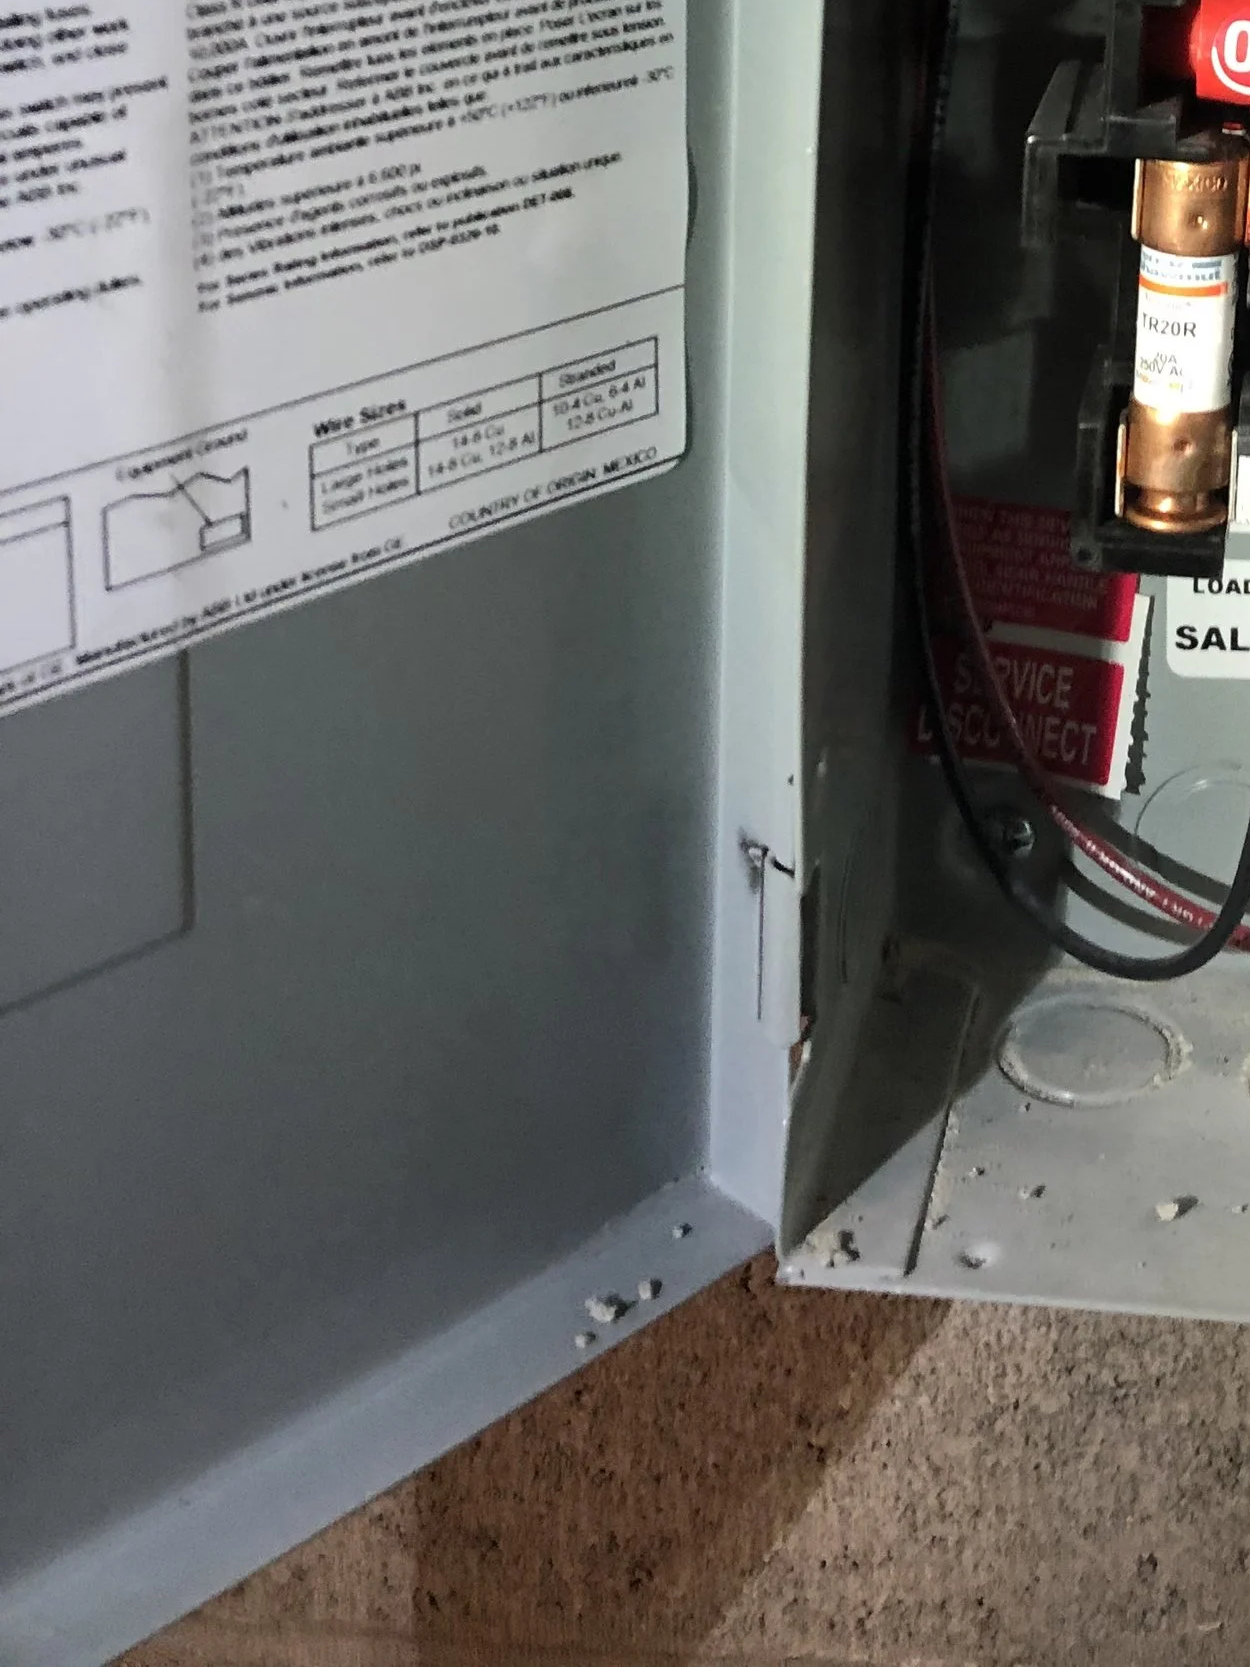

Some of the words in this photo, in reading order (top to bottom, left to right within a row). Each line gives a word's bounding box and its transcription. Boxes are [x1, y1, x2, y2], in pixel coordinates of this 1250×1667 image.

[313, 414, 354, 437] Wire
[359, 399, 407, 424] Sizes
[448, 496, 520, 529] COUNTRY
[602, 446, 657, 476] MEXICO
[1175, 625, 1250, 653] SAL
